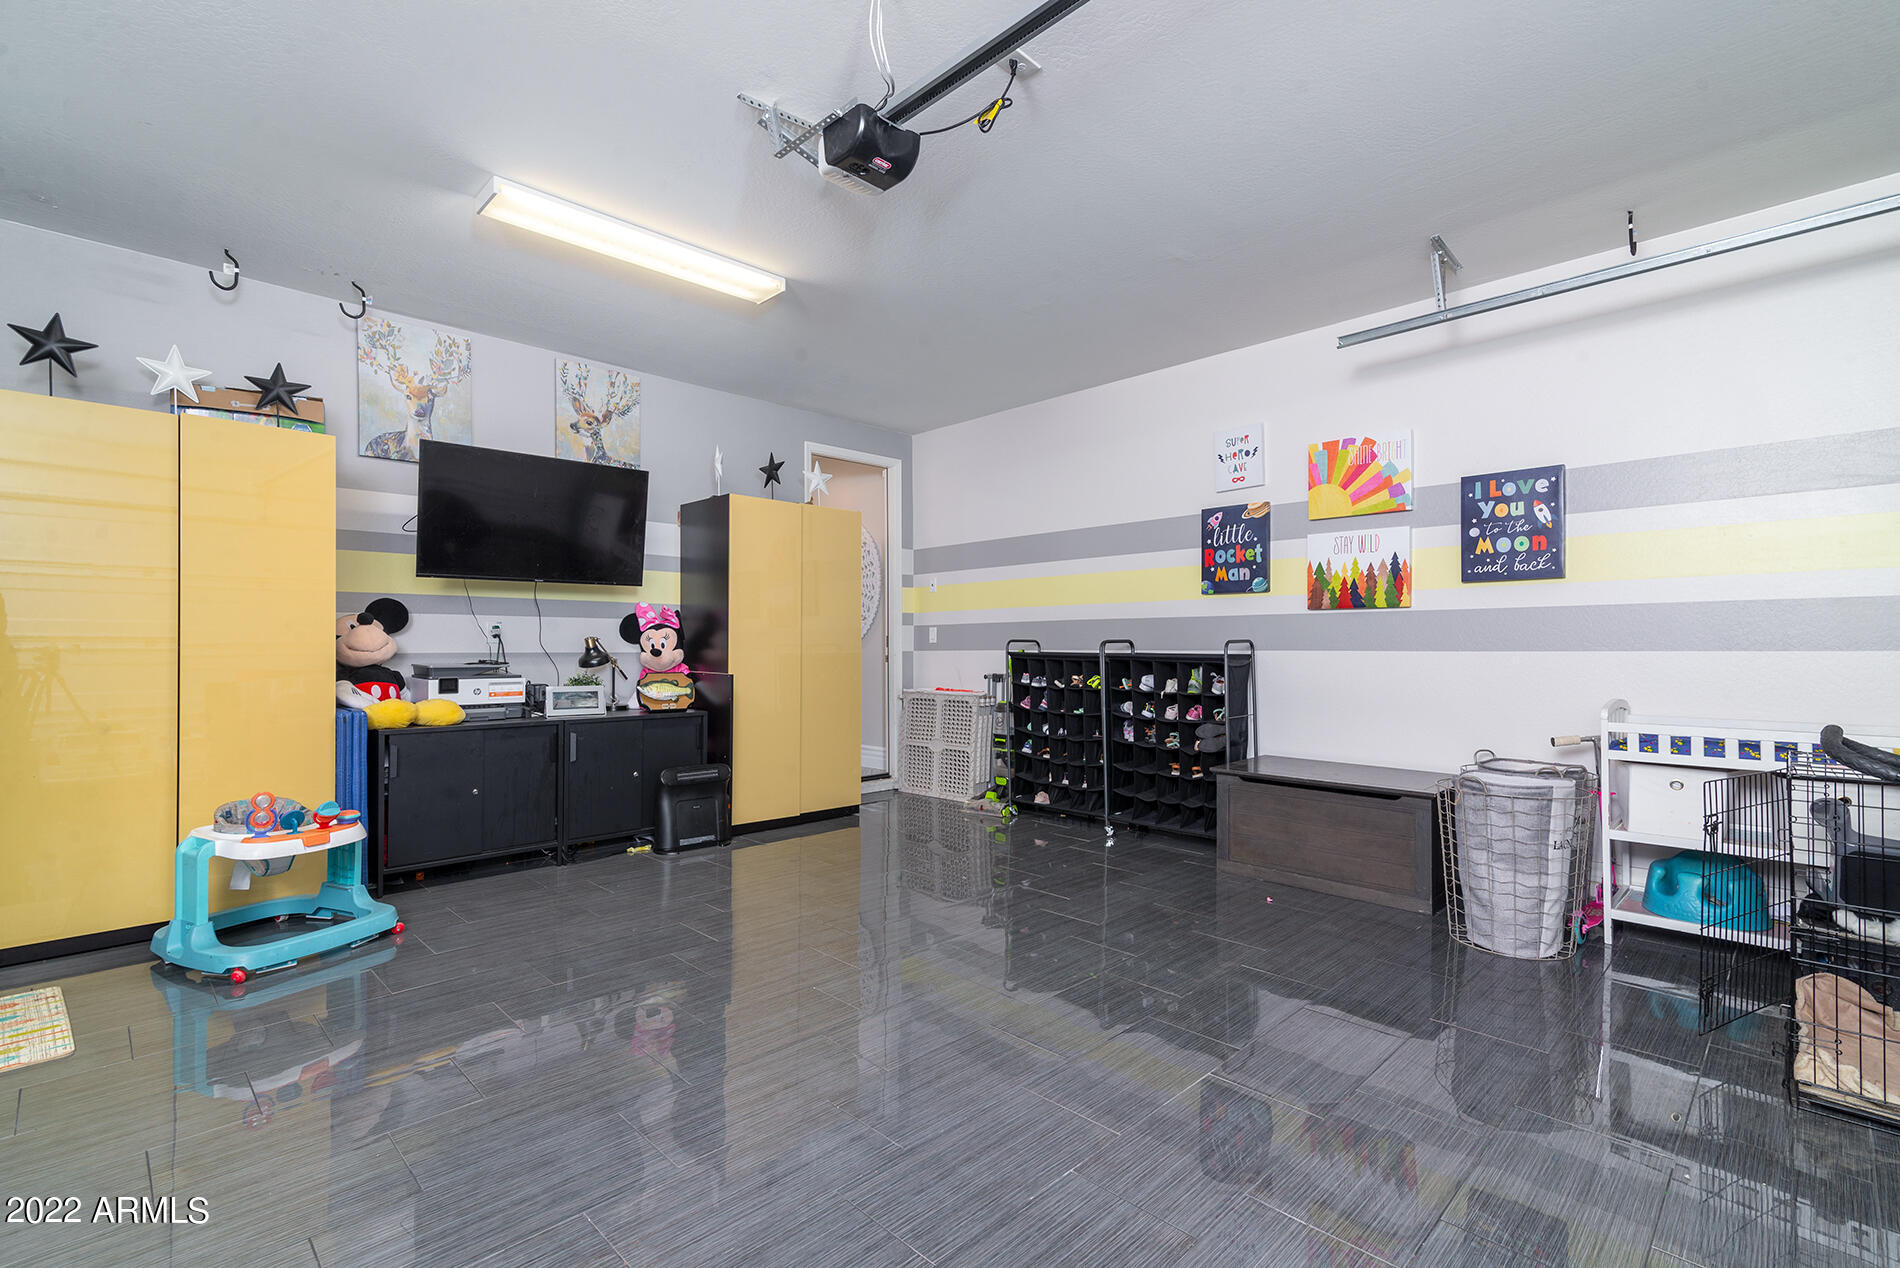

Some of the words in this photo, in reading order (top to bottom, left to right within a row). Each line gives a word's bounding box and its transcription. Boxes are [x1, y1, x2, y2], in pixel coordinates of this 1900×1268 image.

[1348, 444, 1373, 466] SHINE
[1475, 481, 1482, 500] I
[1477, 501, 1525, 519] you
[1213, 523, 1254, 547] little
[1484, 522, 1503, 535] to
[1505, 518, 1533, 534] the
[1333, 536, 1354, 555] STAY
[1357, 534, 1380, 554] WILD
[1475, 535, 1548, 555] Moon
[1204, 544, 1263, 568] Rocket
[1474, 554, 1508, 573] and
[1514, 552, 1552, 572] back
[1215, 566, 1251, 582] Man
